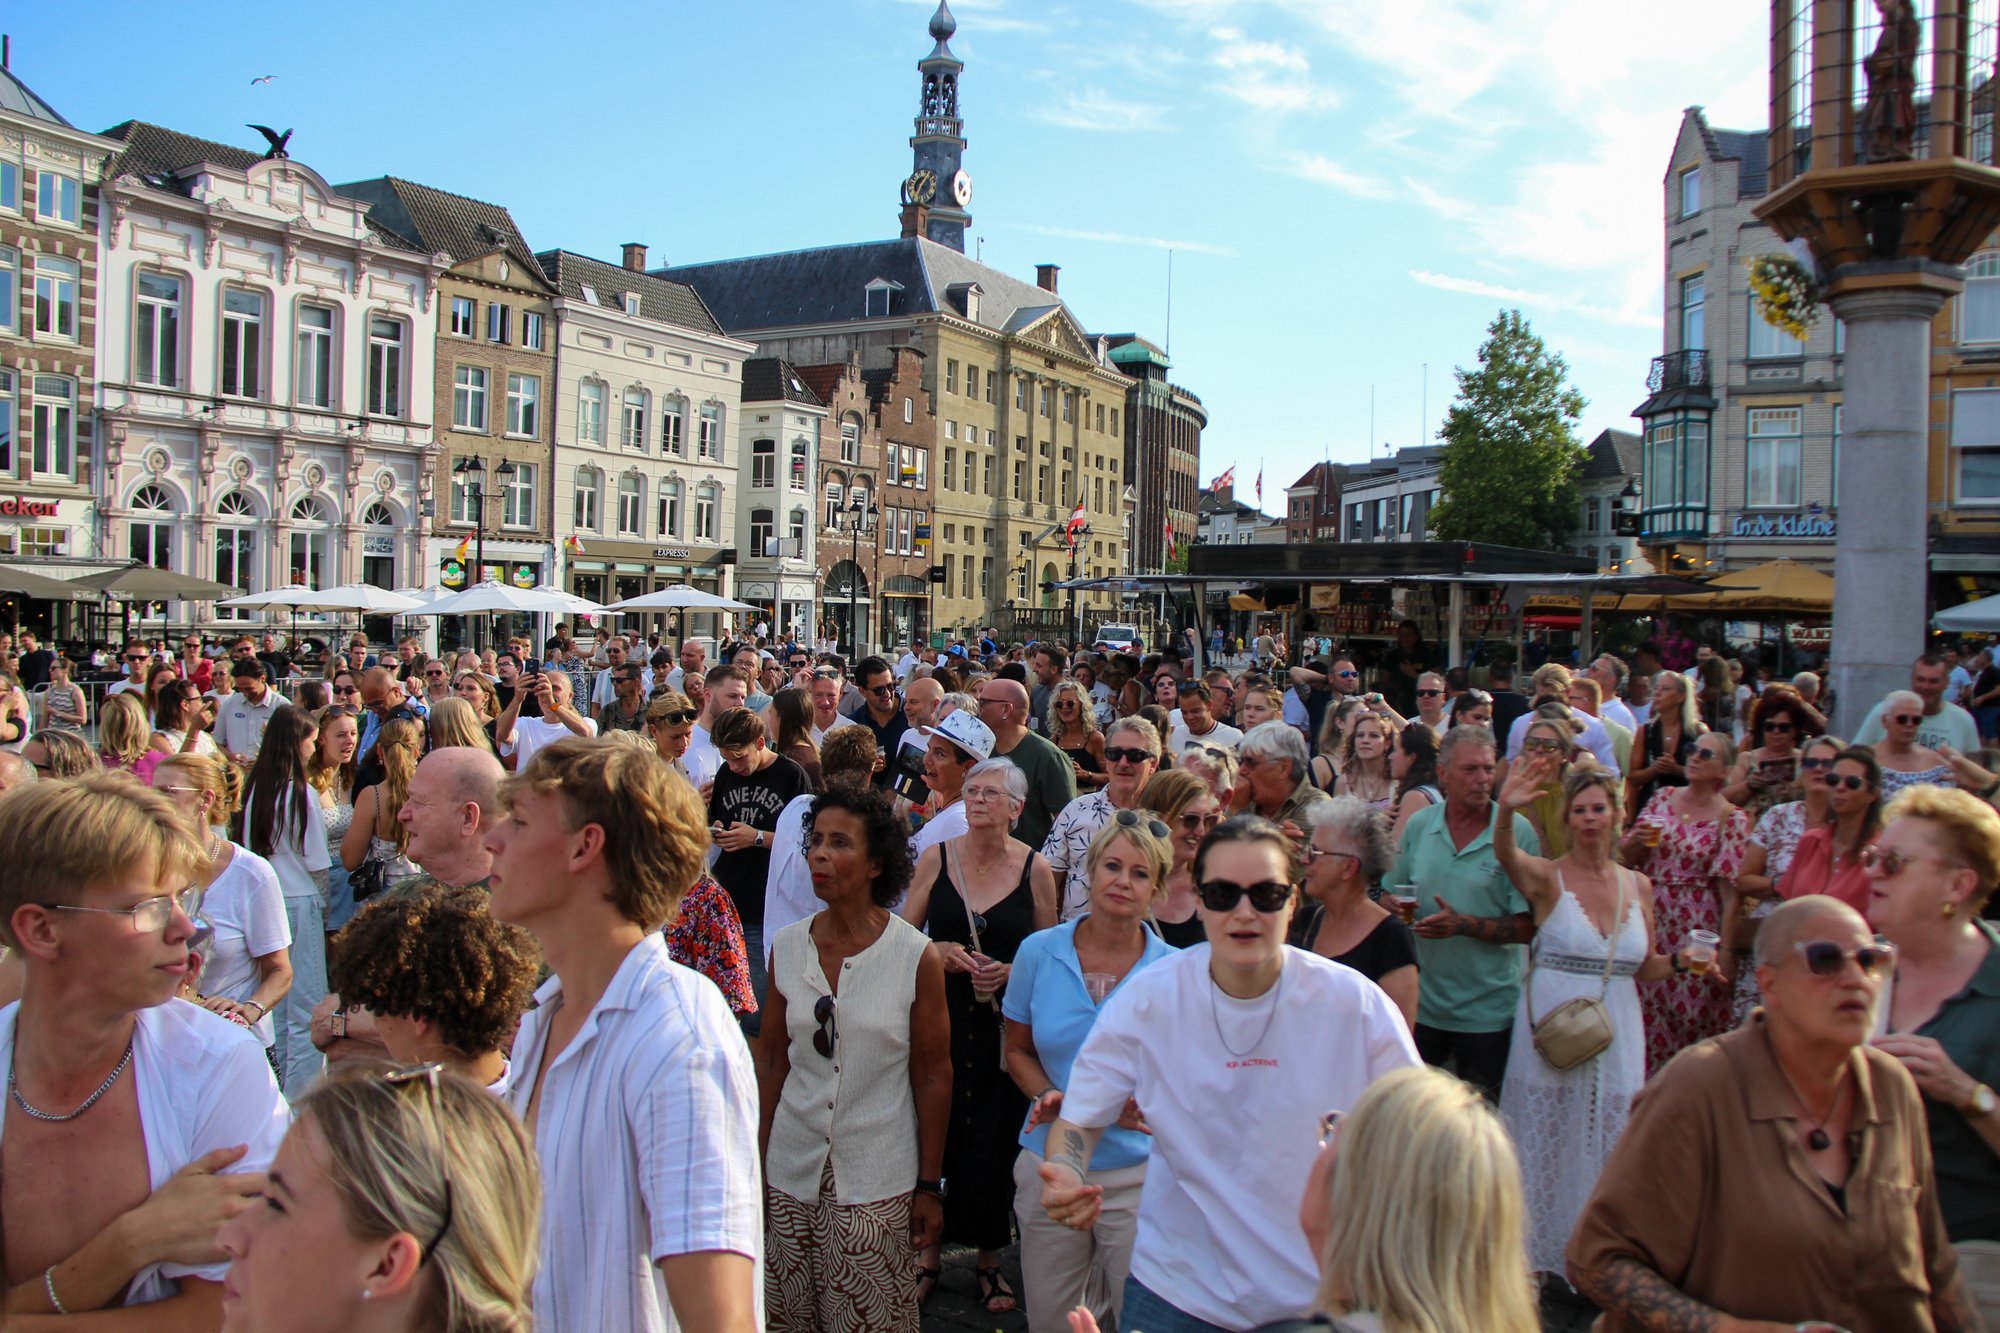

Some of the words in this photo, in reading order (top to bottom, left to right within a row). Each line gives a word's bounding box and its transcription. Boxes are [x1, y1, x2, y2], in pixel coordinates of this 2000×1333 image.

[0, 496, 58, 517] eken
[657, 547, 690, 558] EXPRESSO
[722, 787, 750, 811] LIVE
[752, 786, 785, 814] FAST
